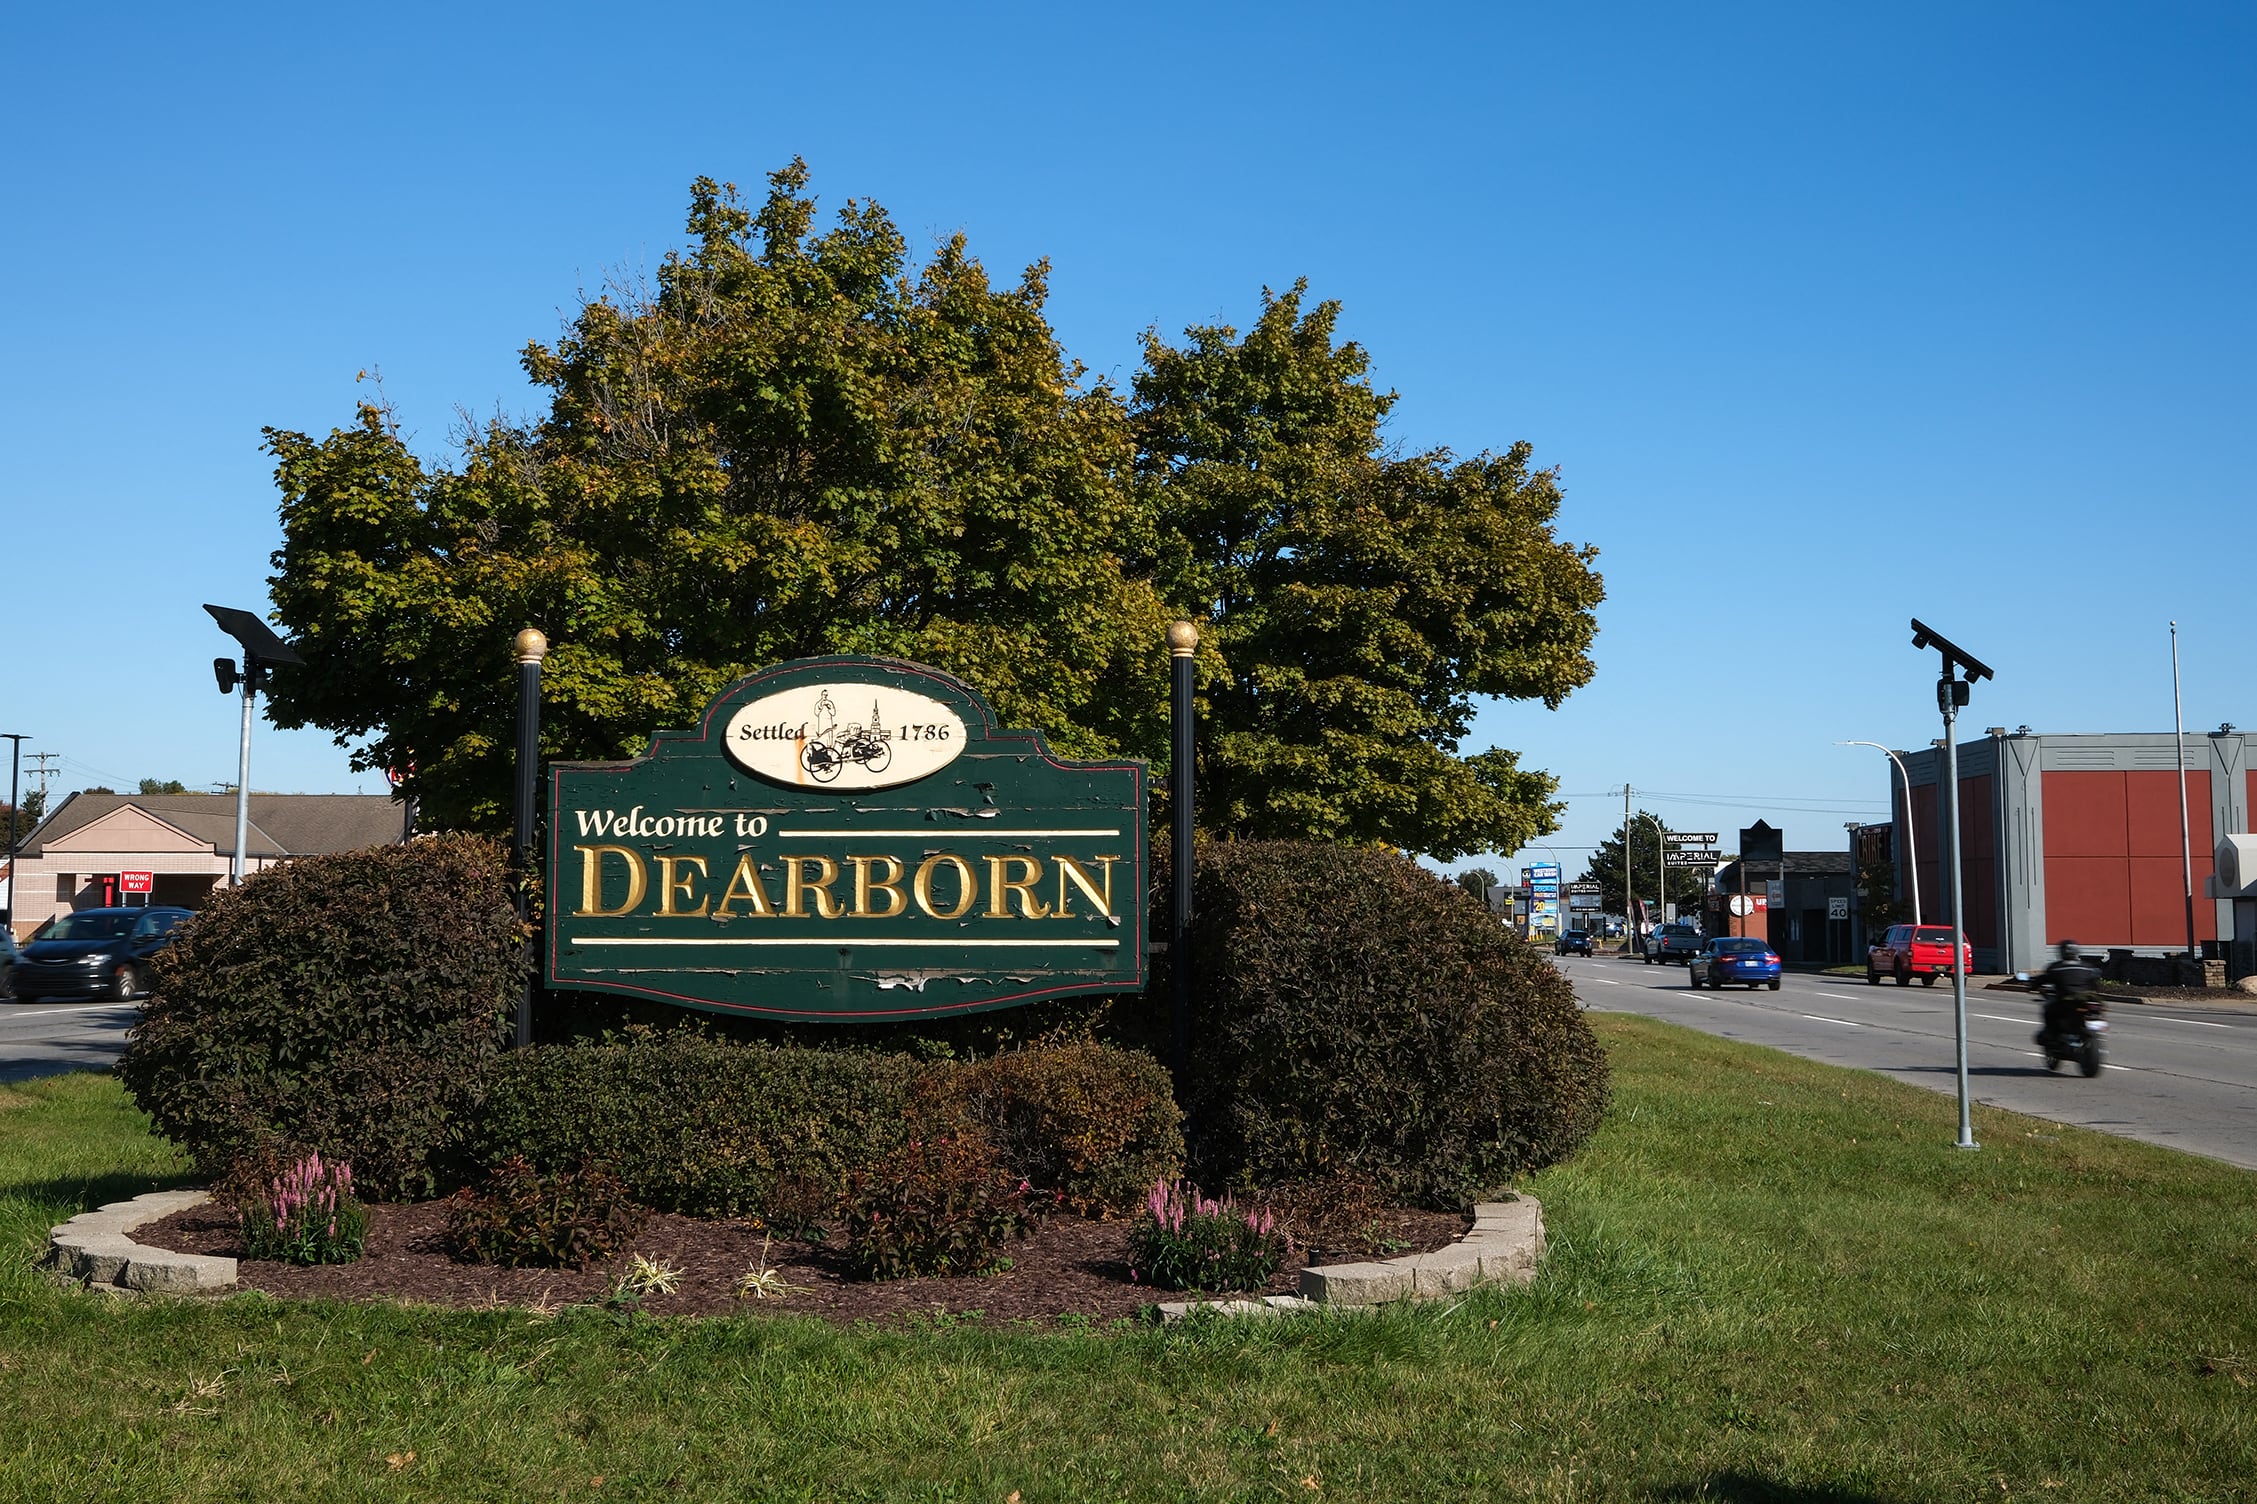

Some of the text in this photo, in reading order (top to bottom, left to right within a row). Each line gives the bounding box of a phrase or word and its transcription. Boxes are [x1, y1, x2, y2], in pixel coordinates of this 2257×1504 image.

[740, 721, 950, 741] Settled 1786
[574, 805, 768, 837] Welcome to
[1666, 834, 1716, 842] WELCOME TO
[1666, 852, 1718, 861] IMPERIAL
[572, 844, 1121, 921] DEARBORN
[1830, 908, 1847, 918] 40
